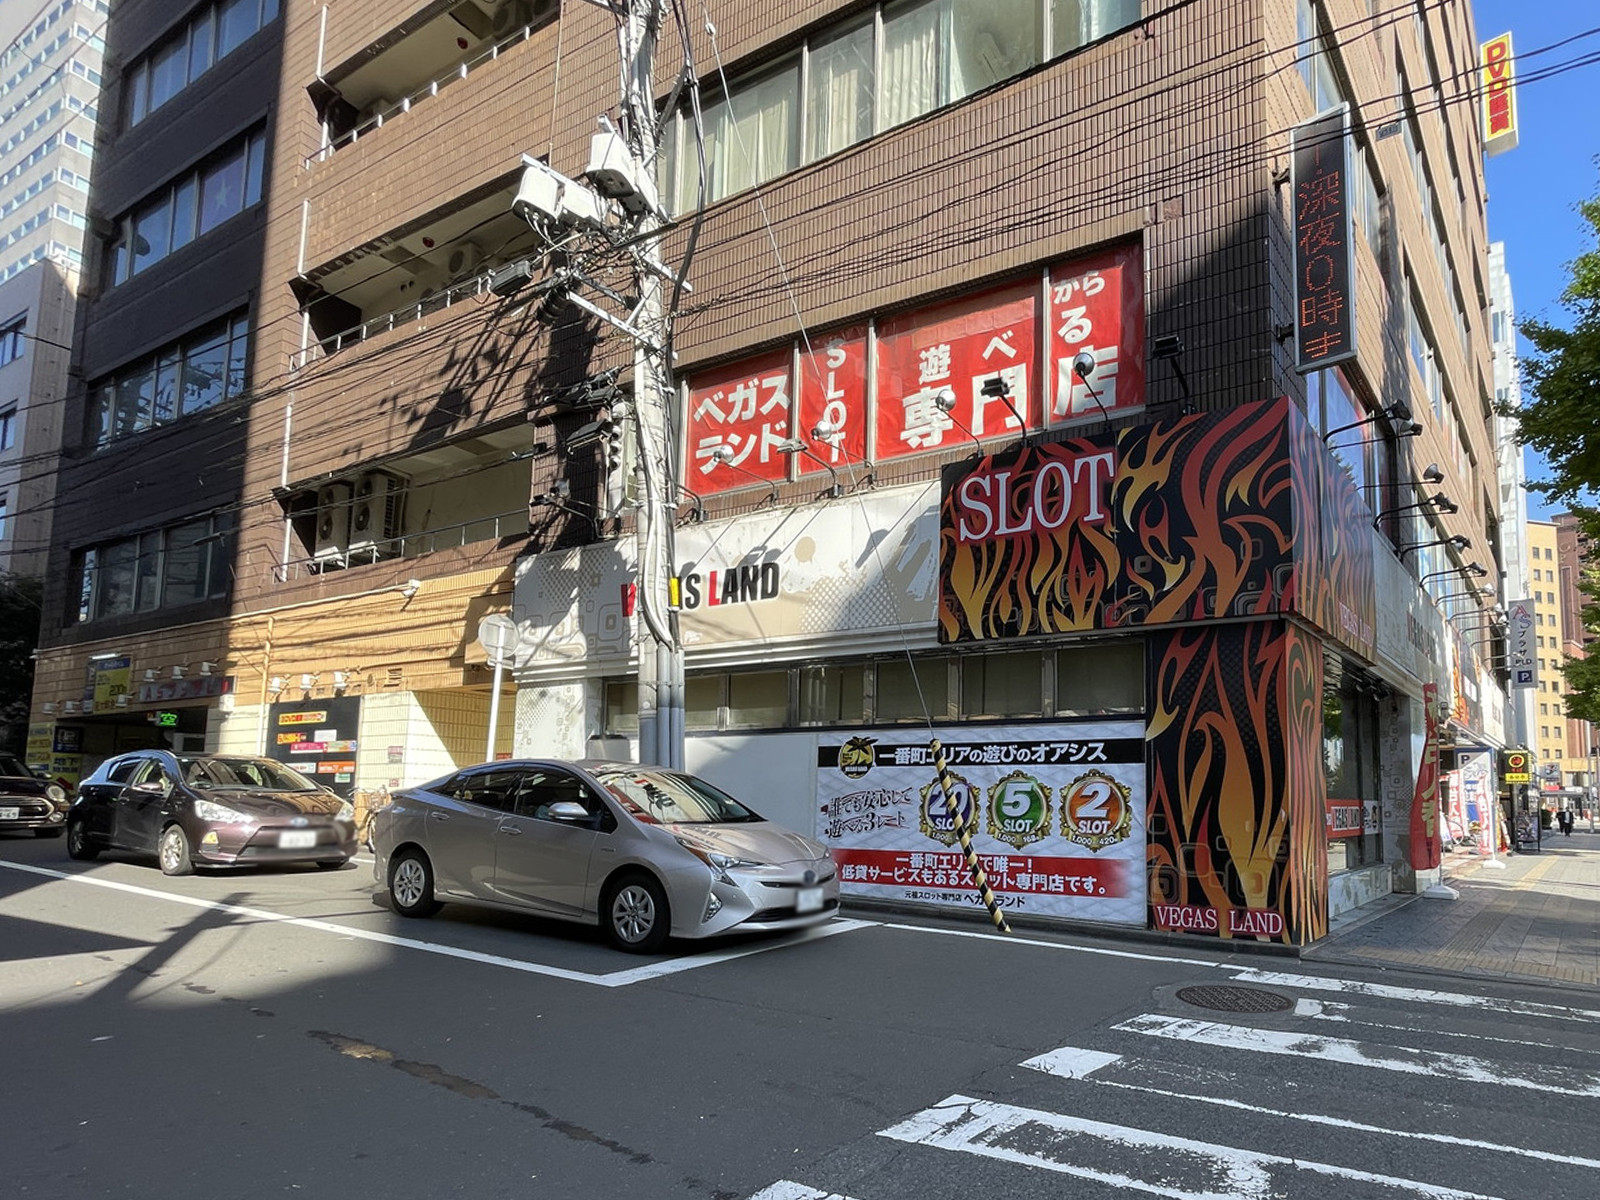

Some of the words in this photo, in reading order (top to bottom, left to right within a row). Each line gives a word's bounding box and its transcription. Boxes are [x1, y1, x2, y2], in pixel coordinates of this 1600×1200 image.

[1053, 271, 1106, 305] から
[693, 374, 791, 425] ベガス
[823, 339, 848, 463] SLOT
[695, 419, 788, 476] ランド
[959, 452, 1115, 542] SLOT
[708, 562, 780, 606] LAND
[1001, 782, 1033, 817] 5
[1076, 783, 1112, 818] 2
[934, 817, 957, 831] SLO
[1003, 819, 1033, 833] SLOT
[1078, 820, 1112, 835] SLOT
[842, 864, 1106, 895] 低貸サービスもあるスット専門店です。
[964, 893, 1026, 908] ベガランド
[1156, 905, 1218, 930] VEGAS
[1230, 910, 1283, 934] LAND
